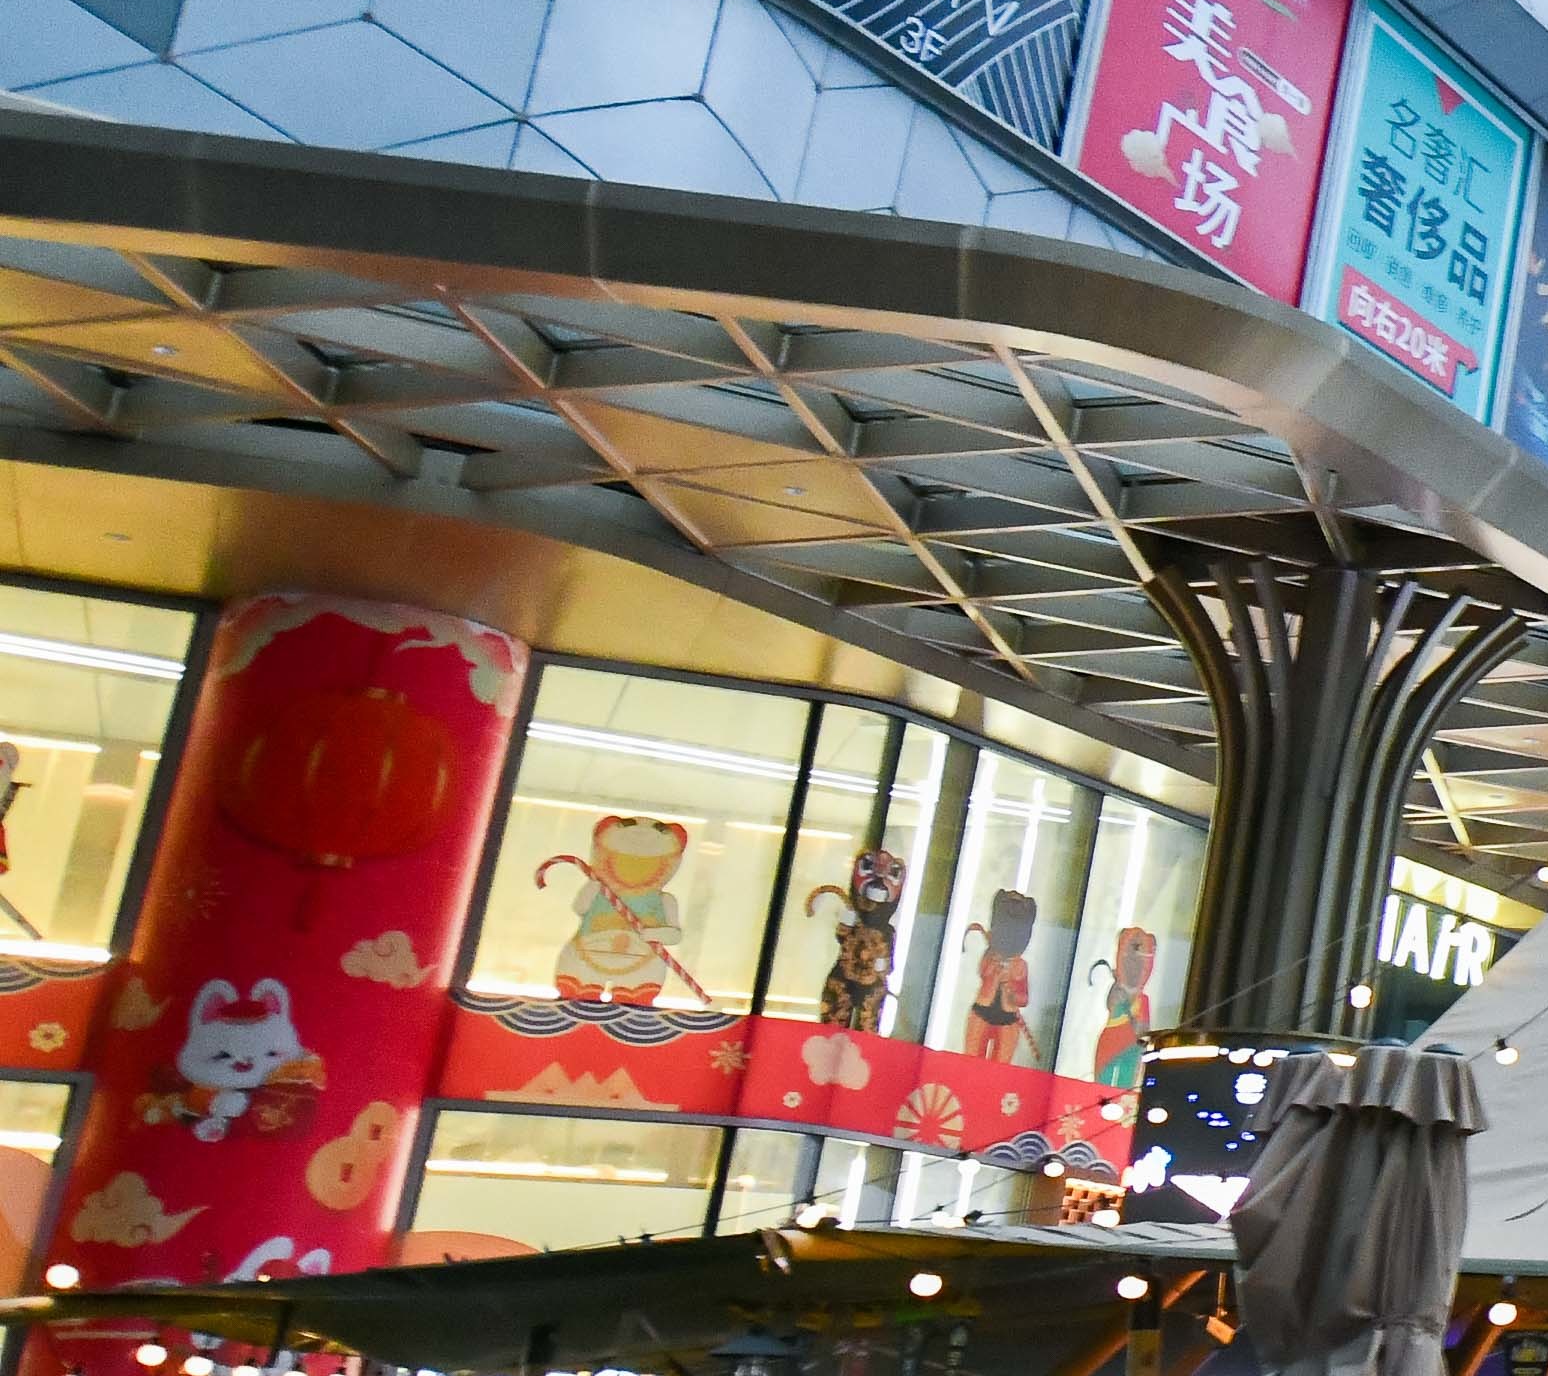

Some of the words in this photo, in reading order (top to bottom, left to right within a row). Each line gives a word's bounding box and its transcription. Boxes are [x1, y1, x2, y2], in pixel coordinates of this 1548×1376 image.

[900, 16, 948, 62] 3F
[1359, 146, 1489, 307] 奢侈品
[1347, 284, 1450, 379] 向右20米
